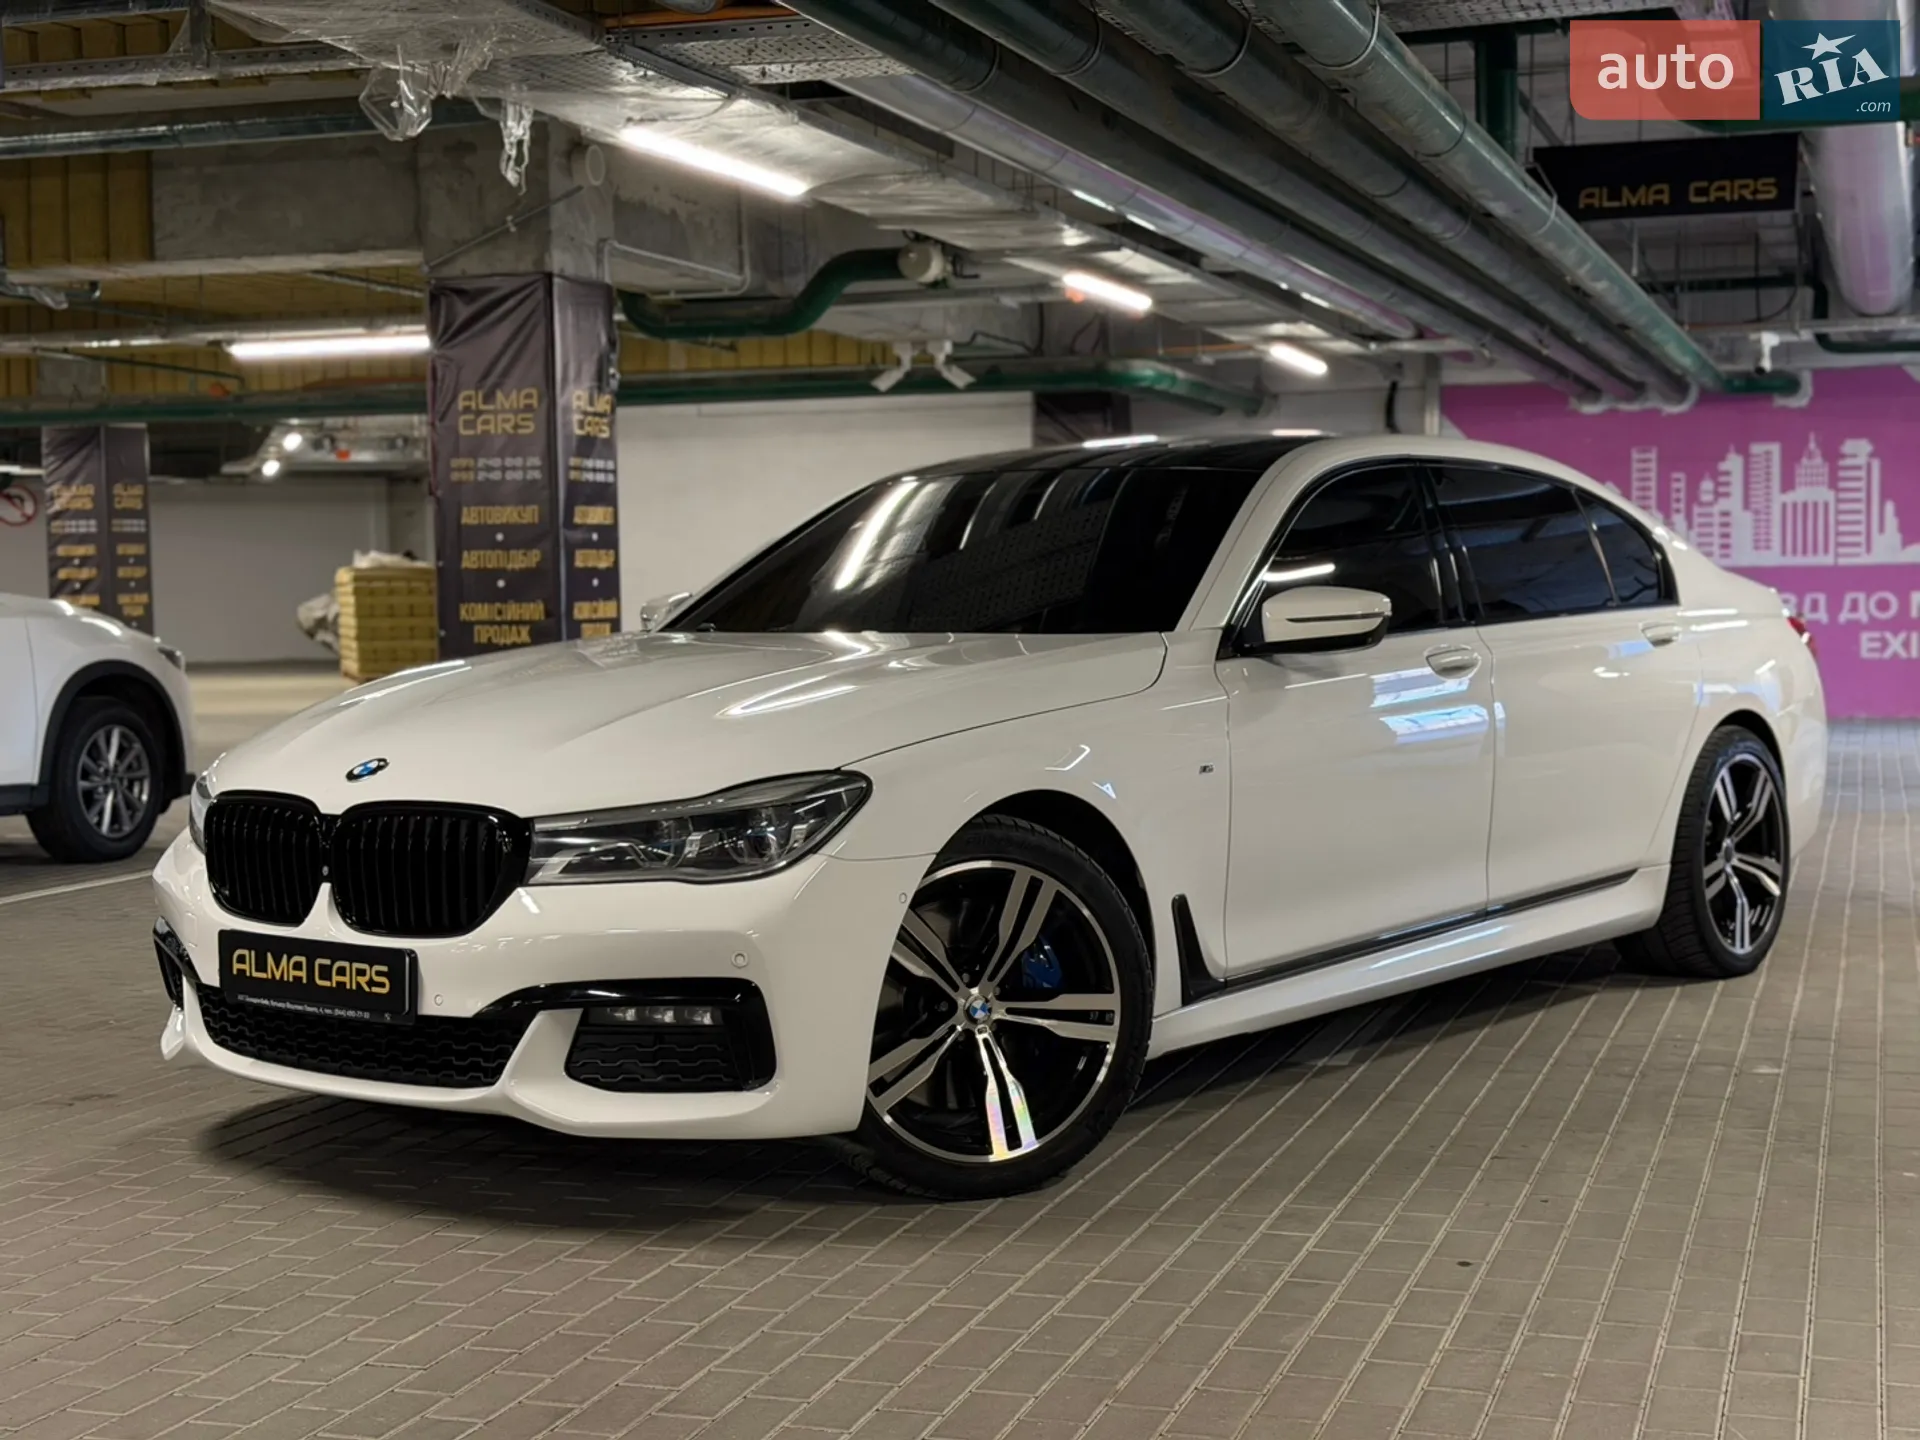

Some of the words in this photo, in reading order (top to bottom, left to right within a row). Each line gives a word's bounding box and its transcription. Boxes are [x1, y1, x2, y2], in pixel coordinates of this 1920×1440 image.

[1579, 183, 1670, 209] ALMA
[1688, 177, 1778, 202] CARS
[457, 387, 538, 411] ALMA
[458, 413, 535, 436] CARS
[461, 505, 539, 524] АВТОВИКУП
[461, 550, 541, 569] АВТОПІДБІР
[1838, 591, 1899, 625] ДО
[473, 625, 531, 643] ПРОДАЖ
[232, 948, 307, 984] ALMA
[314, 958, 390, 994] CARS
